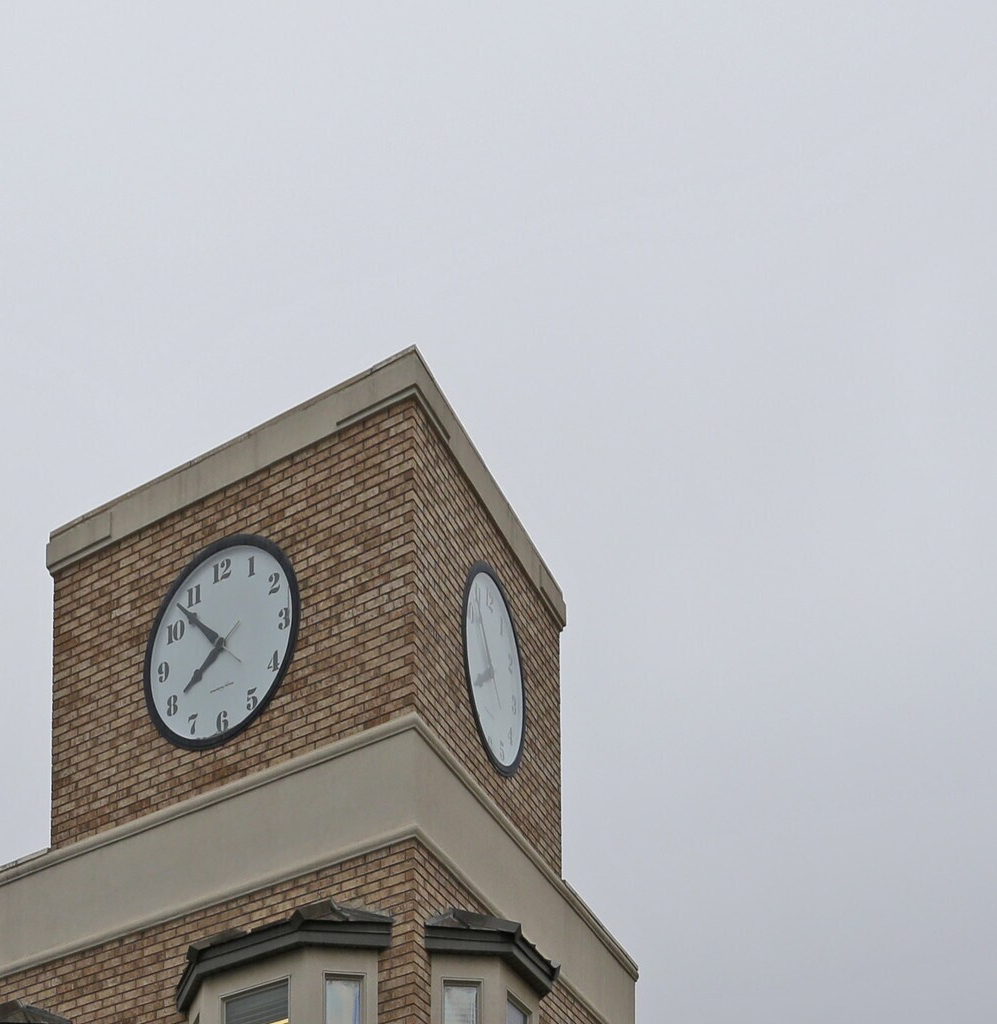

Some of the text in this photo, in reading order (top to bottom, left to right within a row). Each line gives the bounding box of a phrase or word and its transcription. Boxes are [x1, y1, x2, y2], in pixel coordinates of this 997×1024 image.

[212, 558, 232, 584] 12
[247, 556, 256, 578] 1
[268, 572, 281, 596] 2
[186, 584, 202, 609] 11
[277, 607, 290, 630] 3
[166, 619, 186, 646] 10
[157, 661, 170, 683] 9
[267, 649, 280, 672] 4
[166, 694, 179, 717] 8
[246, 687, 258, 711] 5
[187, 713, 199, 735] 7
[216, 710, 229, 733] 6
